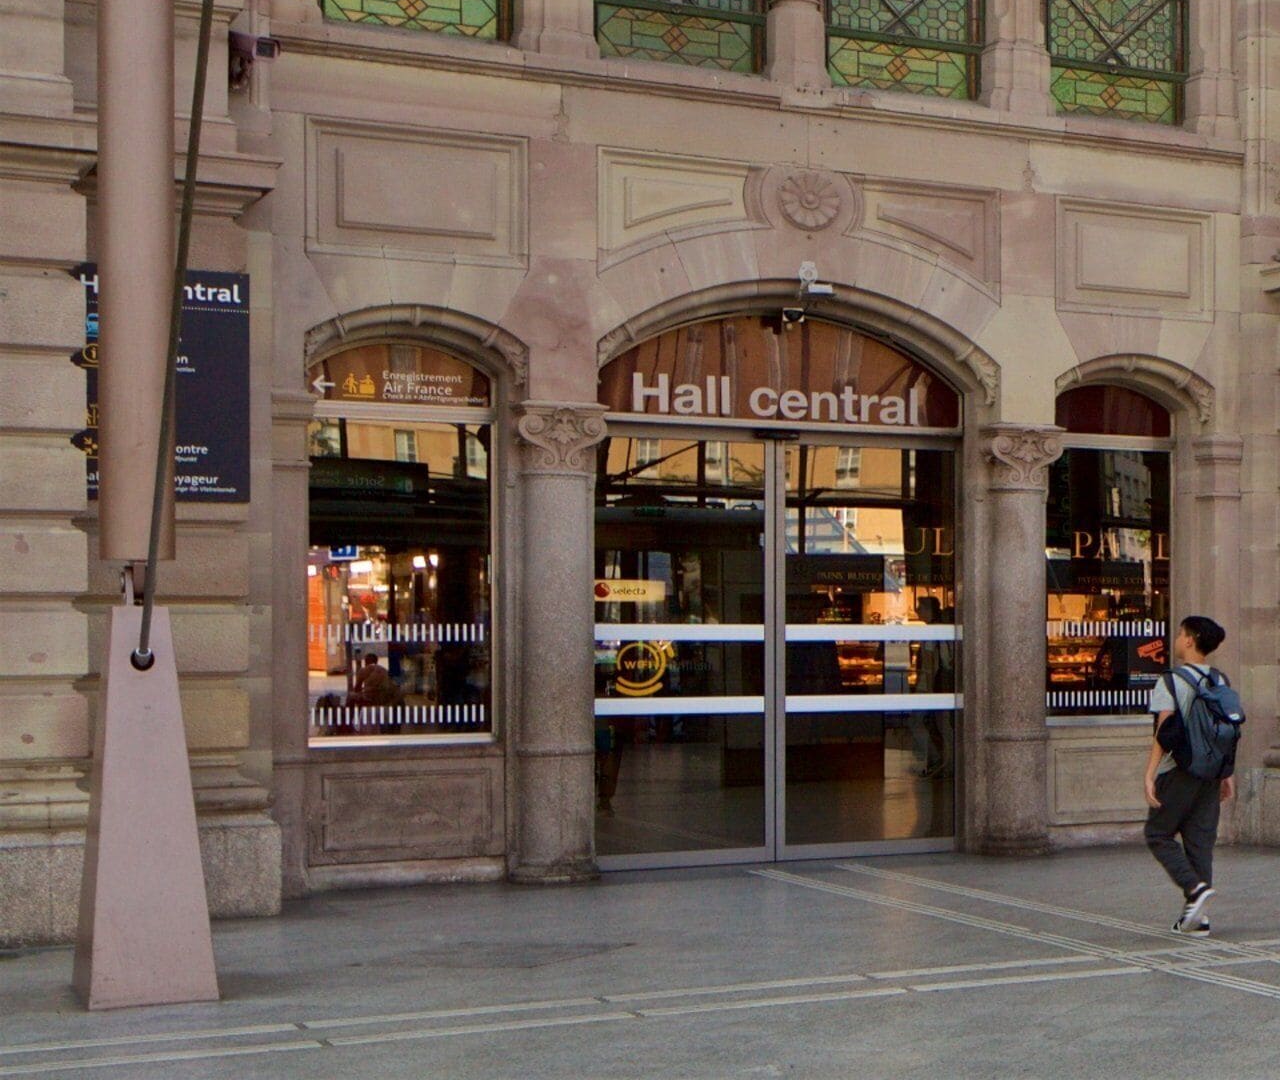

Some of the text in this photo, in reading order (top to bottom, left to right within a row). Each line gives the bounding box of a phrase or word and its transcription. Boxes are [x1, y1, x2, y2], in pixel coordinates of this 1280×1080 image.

[184, 283, 241, 303] ntral
[382, 370, 462, 383] Enregistrement
[383, 381, 453, 395] Air France
[633, 372, 919, 426] Hall central
[175, 444, 208, 455] ontre
[175, 474, 218, 486] yageur
[904, 527, 954, 556] UL
[1071, 531, 1169, 560] PAL
[612, 587, 646, 596] selecta
